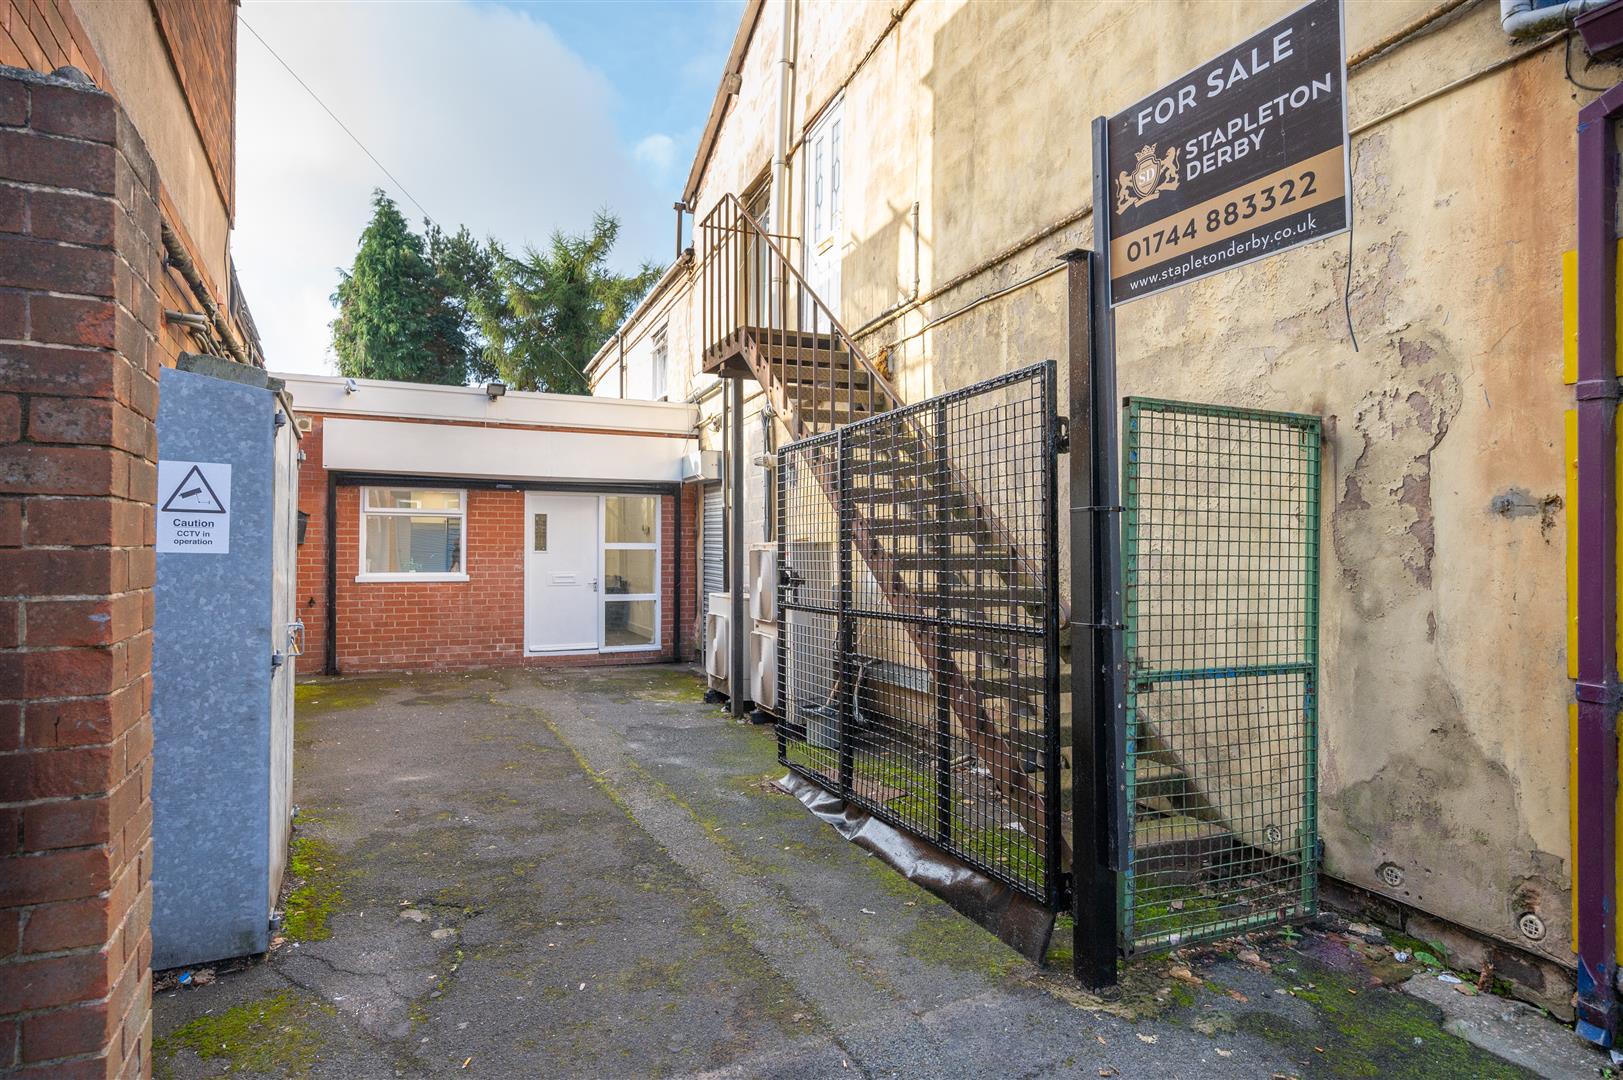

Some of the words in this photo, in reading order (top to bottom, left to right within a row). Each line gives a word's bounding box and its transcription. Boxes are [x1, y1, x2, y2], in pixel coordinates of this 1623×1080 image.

[1137, 84, 1197, 136] FOR
[1206, 28, 1294, 98] SALE
[1185, 72, 1332, 160] STAPLETON
[1138, 168, 1155, 185] SD
[1186, 128, 1266, 181] DERBY
[1127, 218, 1197, 262] 01744
[1205, 170, 1317, 233] 883322
[1129, 213, 1317, 290] www.stapletonderby.co.uk
[173, 518, 215, 528] Caution
[173, 538, 213, 546] operation
